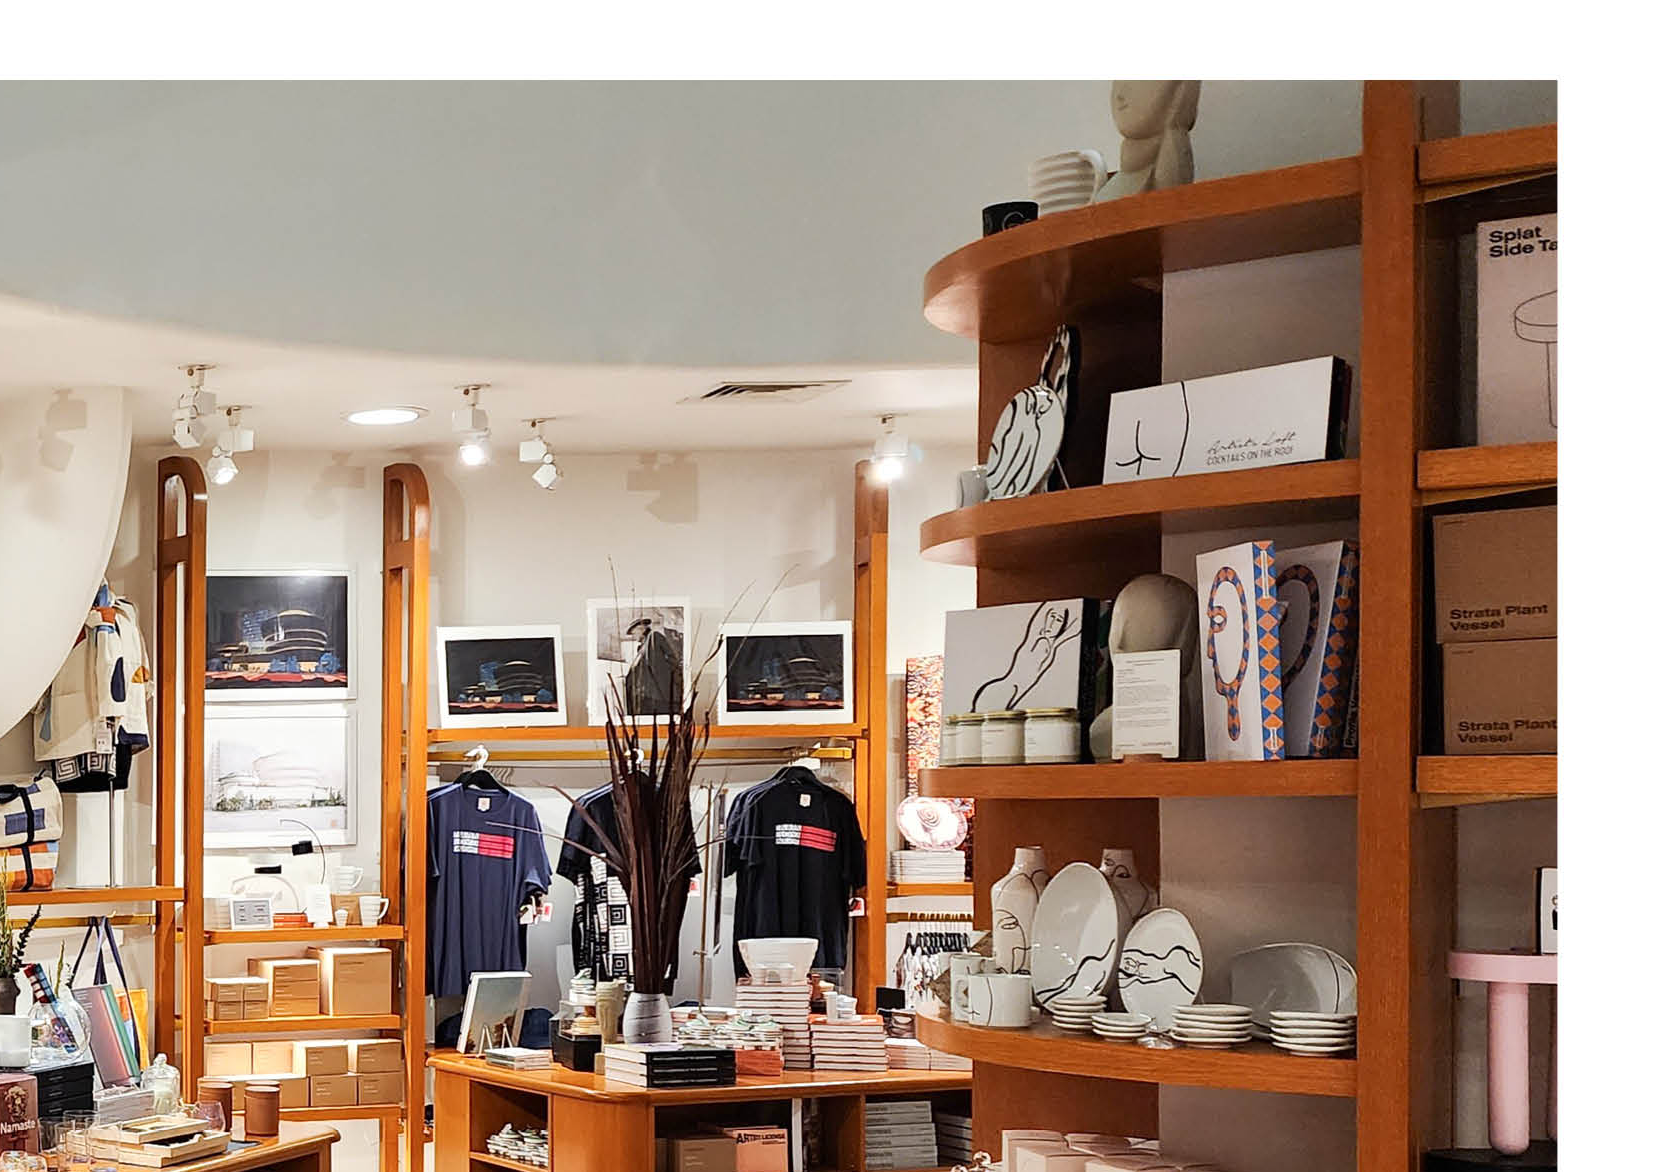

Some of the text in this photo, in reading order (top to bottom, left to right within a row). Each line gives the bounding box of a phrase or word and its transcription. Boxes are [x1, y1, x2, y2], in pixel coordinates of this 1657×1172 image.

[1488, 226, 1542, 243] Splat
[1488, 243, 1535, 258] Side
[1449, 604, 1549, 620] Strata Plant
[1449, 618, 1506, 631] Vessel
[1458, 719, 1557, 732] Strata Plant
[1457, 732, 1514, 744] Vessel
[0, 1119, 36, 1135] Namaste
